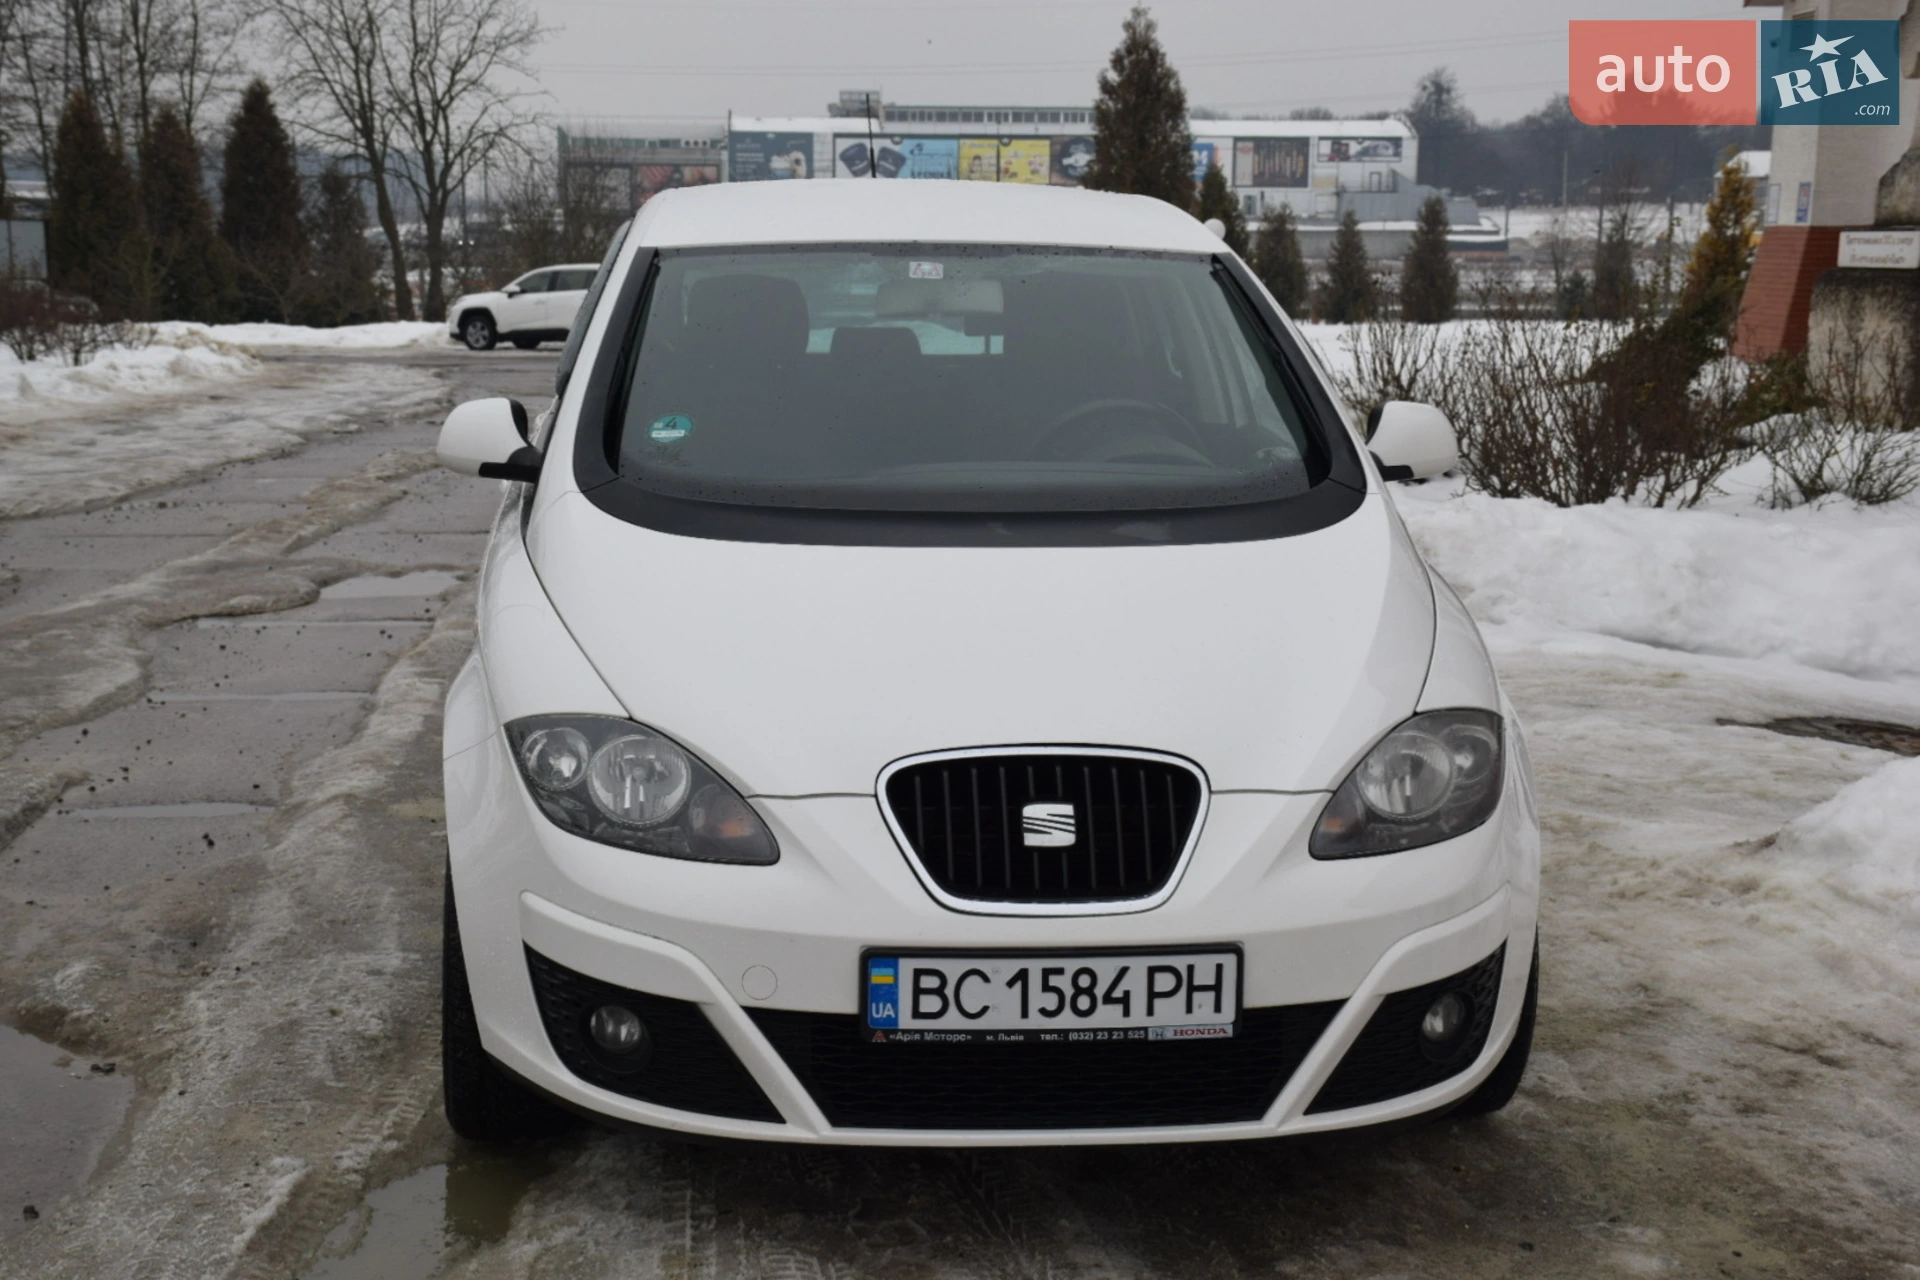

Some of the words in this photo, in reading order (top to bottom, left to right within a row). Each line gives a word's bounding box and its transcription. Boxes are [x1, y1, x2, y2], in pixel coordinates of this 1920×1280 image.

[911, 967, 991, 1020] BC
[1005, 965, 1131, 1020] 1584
[1146, 962, 1224, 1017] PH
[872, 1003, 895, 1018] UA
[1068, 1031, 1094, 1042] (032)
[1096, 1031, 1109, 1040] 23
[1112, 1031, 1124, 1039] 23
[1128, 1030, 1145, 1039] 525
[1172, 1027, 1229, 1037] HONDA
